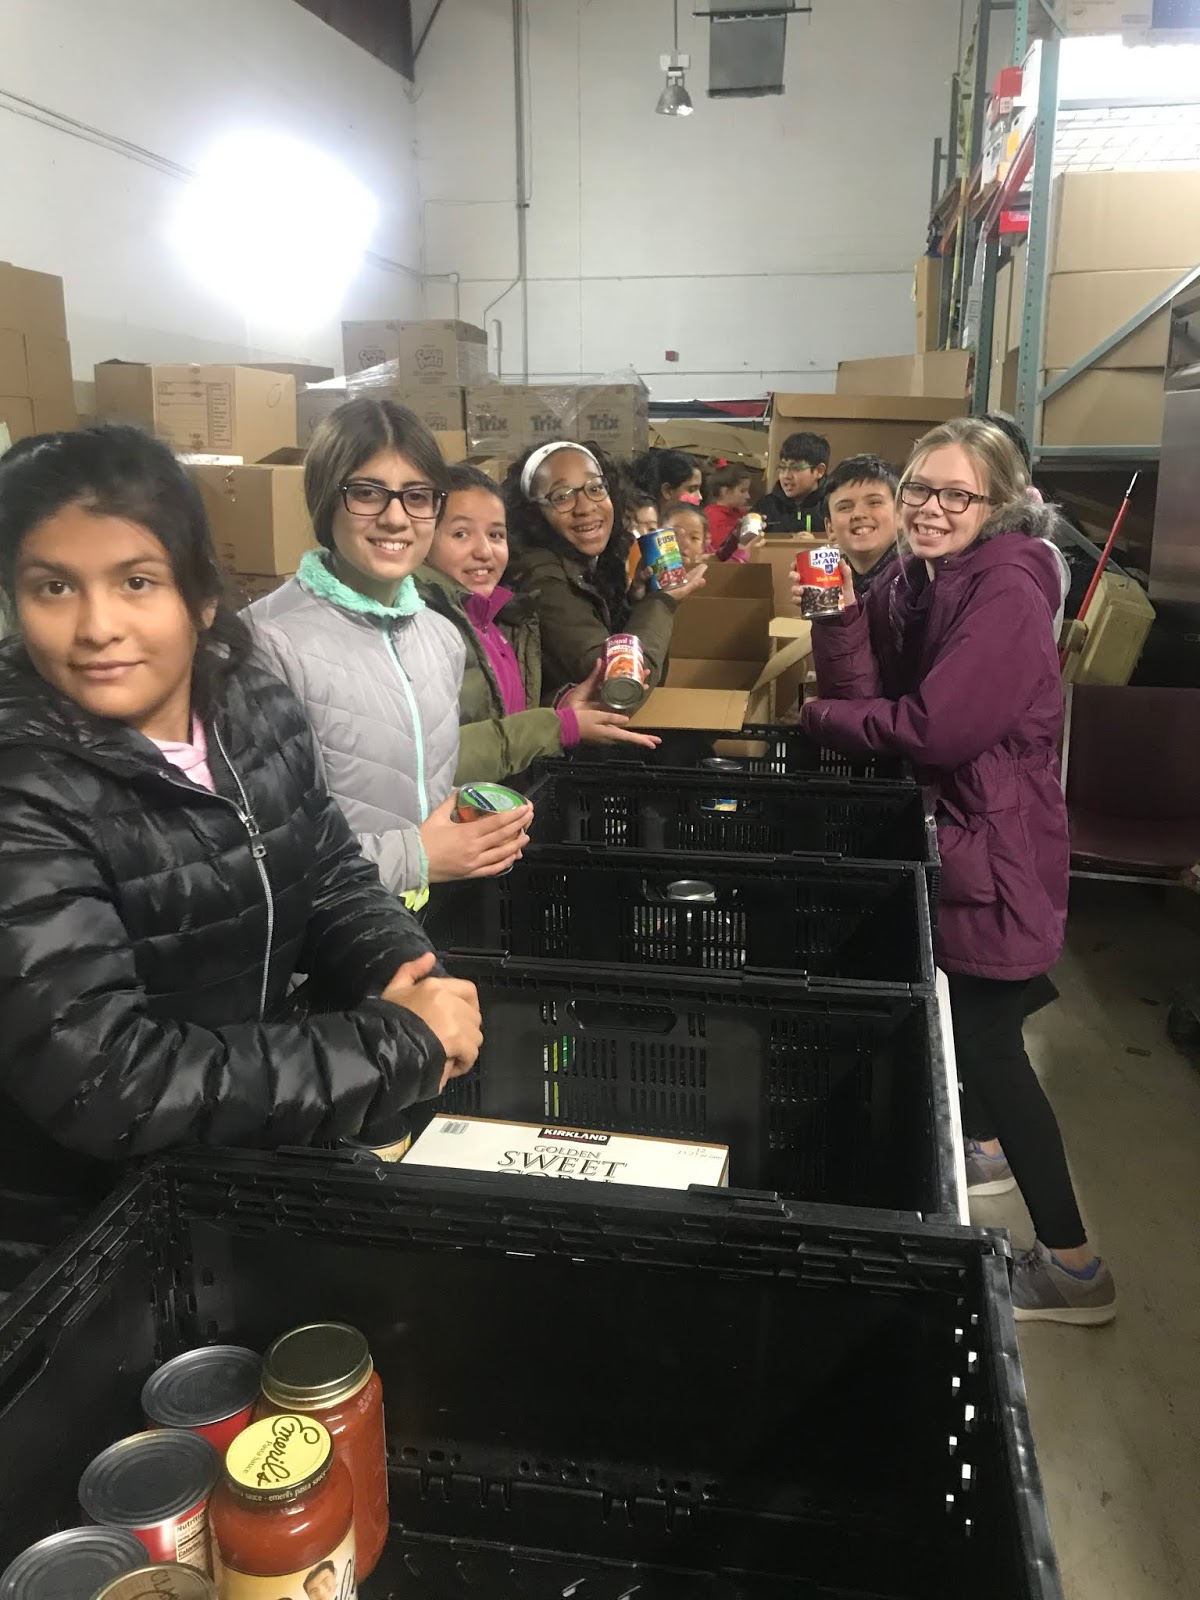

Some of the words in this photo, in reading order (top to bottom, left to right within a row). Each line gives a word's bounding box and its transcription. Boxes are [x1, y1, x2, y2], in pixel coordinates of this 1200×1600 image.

[475, 414, 508, 432] Trix
[530, 414, 563, 432] Trix
[586, 412, 620, 431] Trix
[543, 1128, 608, 1141] KIRKLAND
[534, 1145, 601, 1159] GOLDEN
[497, 1150, 628, 1179] SWEET
[256, 1415, 321, 1487] Emeril's
[257, 1440, 273, 1457] Pasta
[242, 1454, 262, 1474] Sauce
